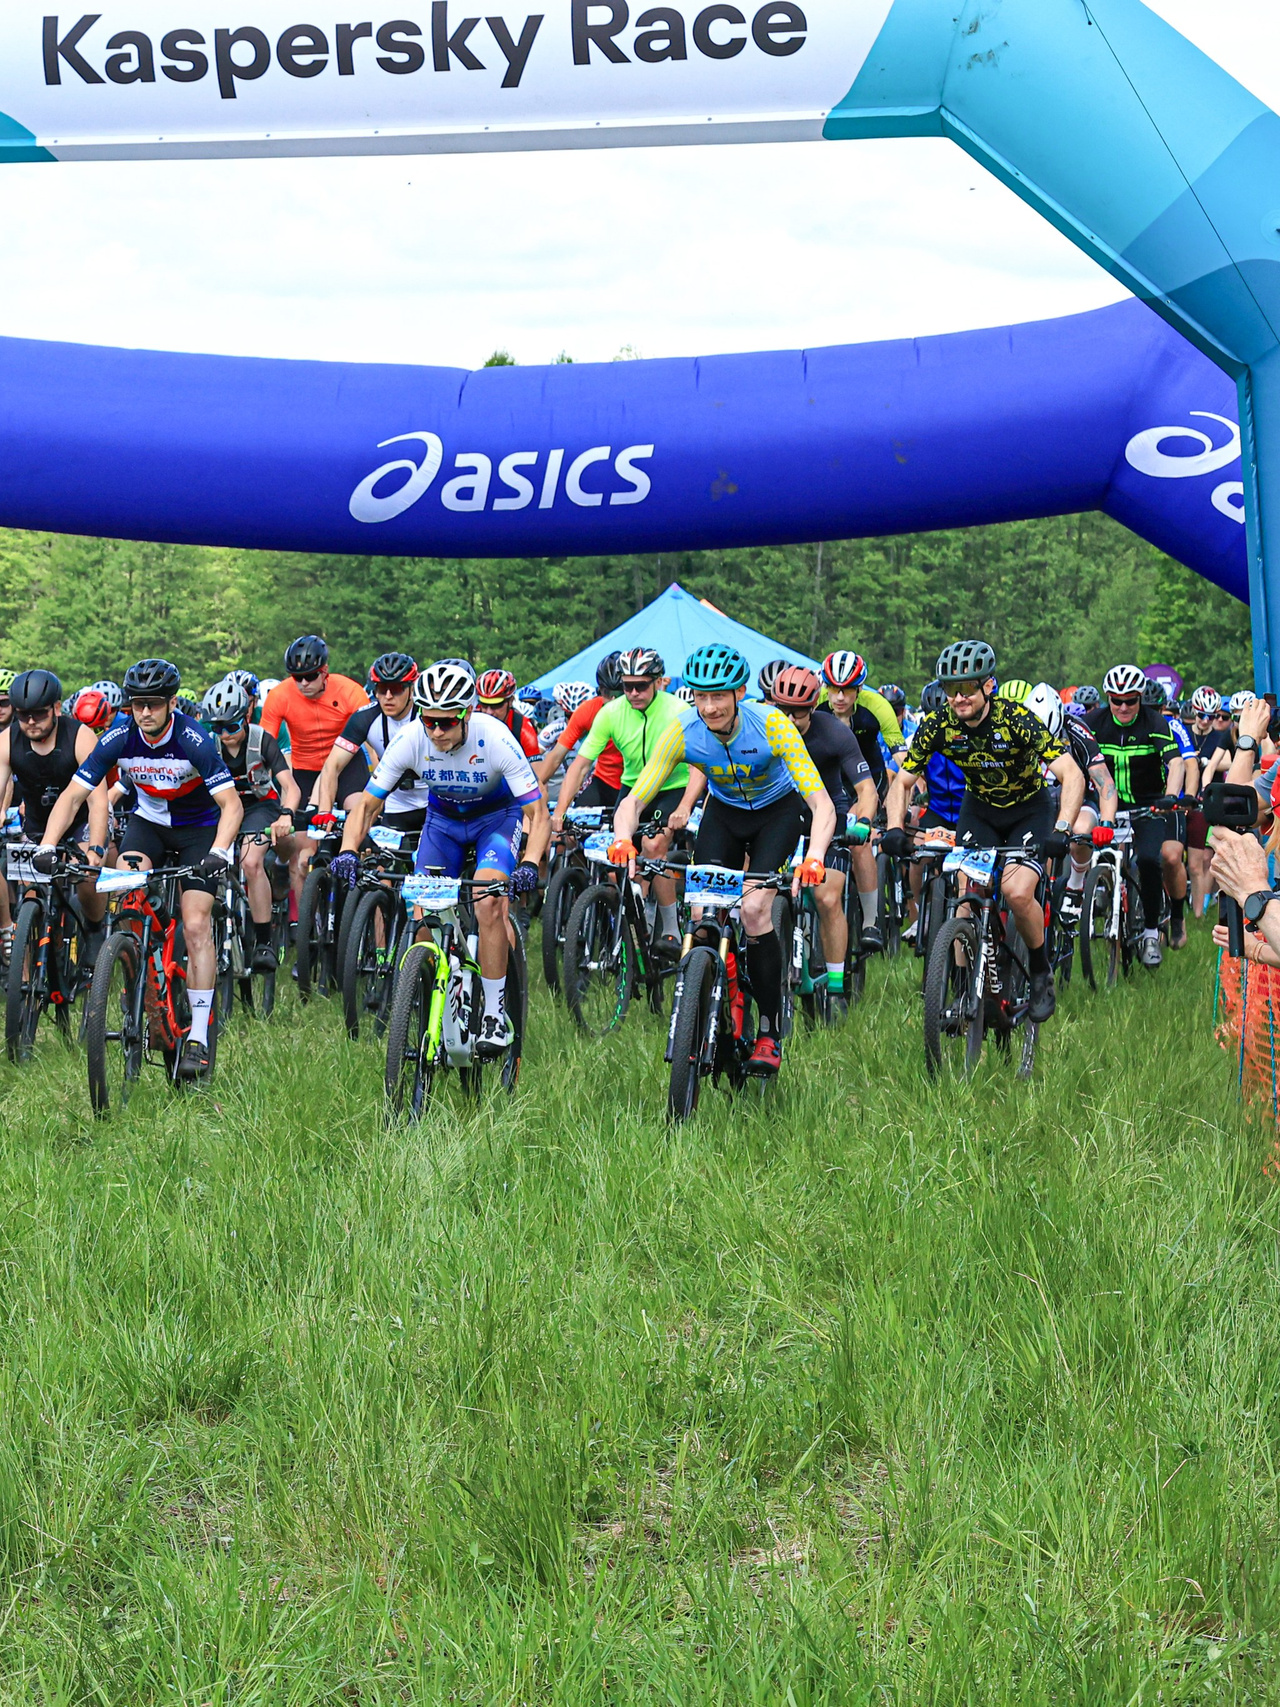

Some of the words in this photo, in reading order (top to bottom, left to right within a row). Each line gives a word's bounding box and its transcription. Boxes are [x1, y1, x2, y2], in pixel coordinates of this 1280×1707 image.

[42, 0, 545, 99] Kaspersky
[571, 0, 808, 66] Race
[422, 768, 488, 783] 成都高新
[11, 849, 40, 863] 99
[690, 871, 738, 888] 4754
